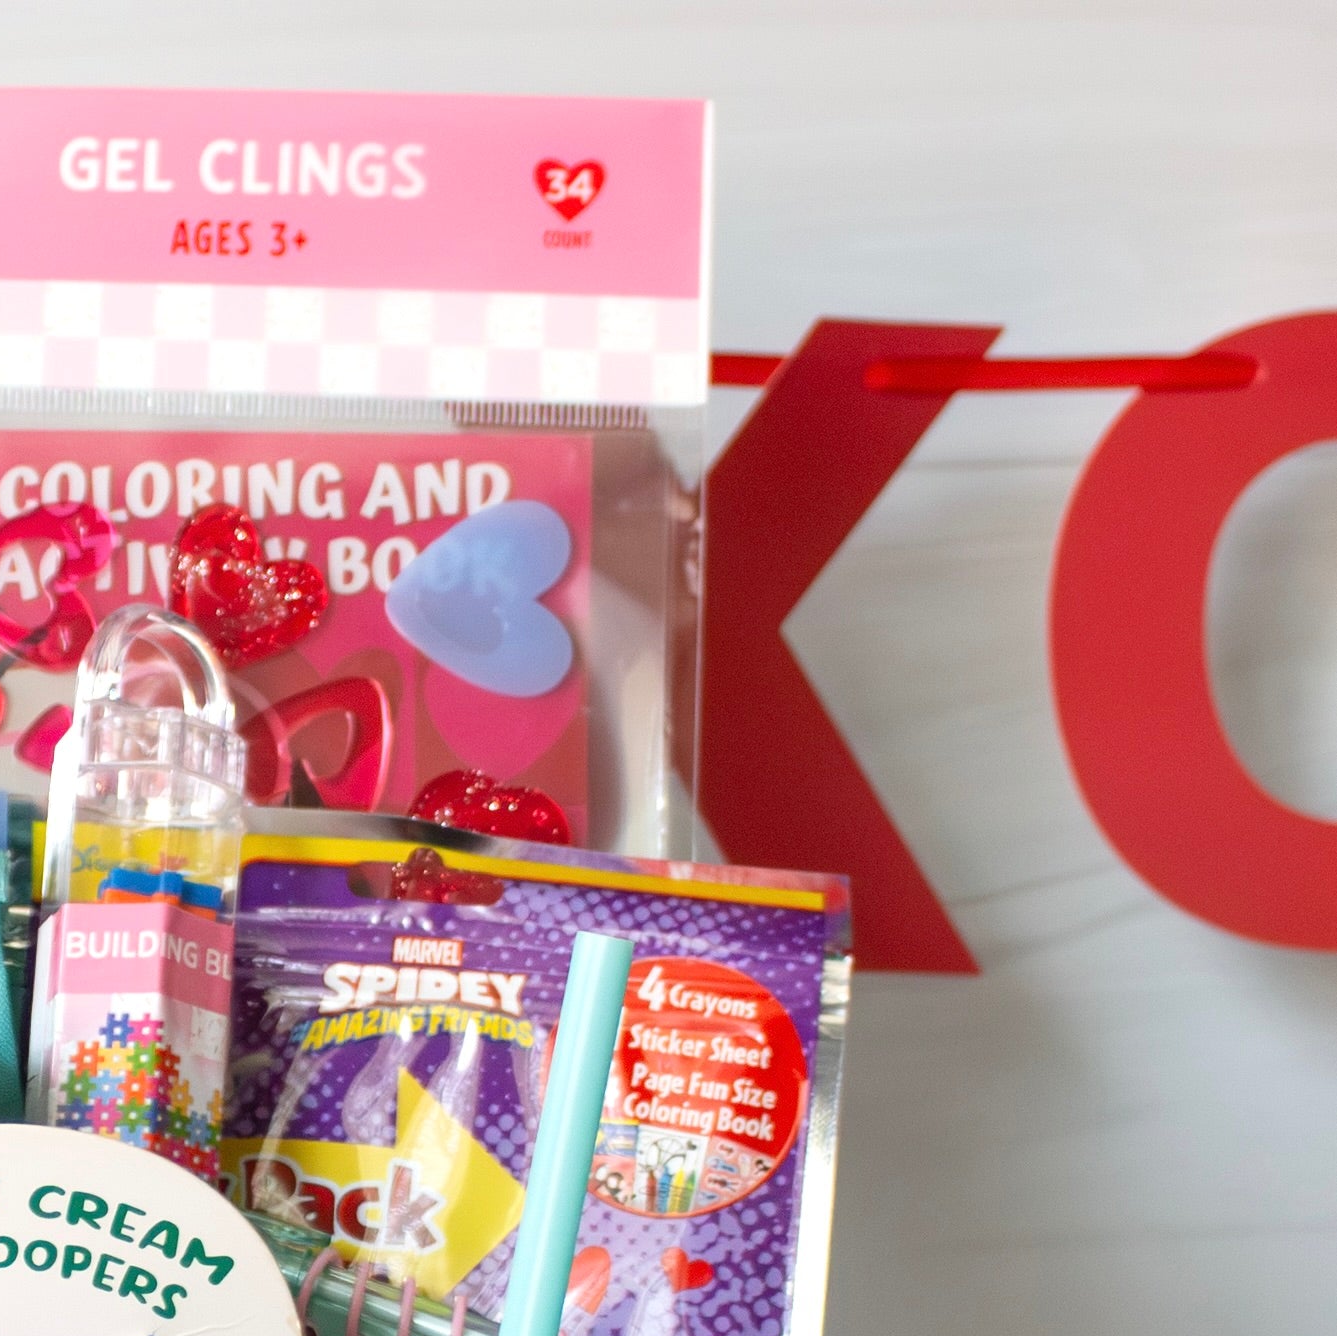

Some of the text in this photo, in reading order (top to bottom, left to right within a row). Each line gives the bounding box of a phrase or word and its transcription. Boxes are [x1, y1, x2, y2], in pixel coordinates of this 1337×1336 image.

[60, 137, 427, 199] GEL CLINGS
[545, 168, 593, 203] 34
[170, 219, 309, 257] AGES 3+
[543, 230, 593, 249] COUNT
[360, 458, 511, 526] AND
[65, 930, 199, 970] BUILDING
[393, 937, 462, 966] MARVEL
[319, 963, 528, 1017] SPIDEY
[637, 965, 758, 1019] 4 Crayons
[301, 1004, 426, 1051] AMAZING
[426, 1004, 535, 1048] FRIENDS
[628, 1023, 773, 1069] Sticker Sheet
[630, 1062, 684, 1097] Page
[687, 1072, 729, 1101] Fun
[731, 1078, 778, 1110] Size
[623, 1093, 775, 1142] Coloring Book
[241, 1156, 444, 1253] Pack
[28, 1183, 235, 1286] CREAM
